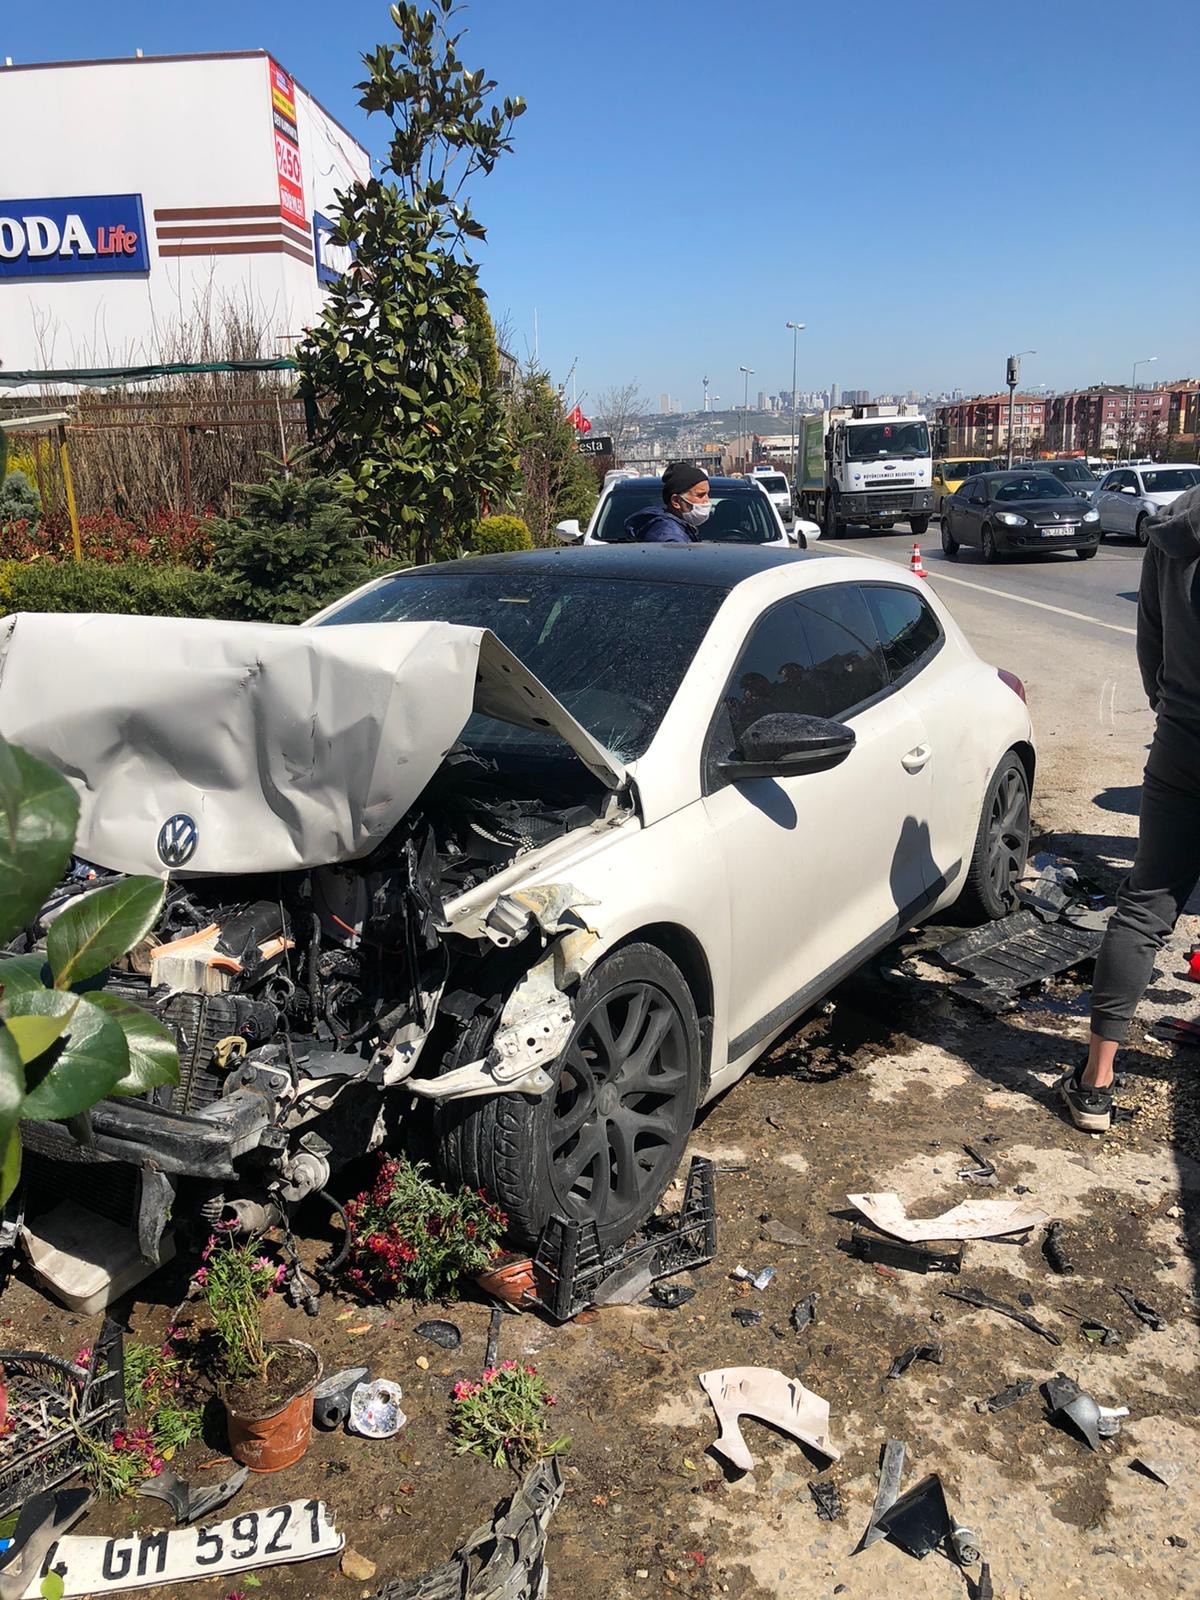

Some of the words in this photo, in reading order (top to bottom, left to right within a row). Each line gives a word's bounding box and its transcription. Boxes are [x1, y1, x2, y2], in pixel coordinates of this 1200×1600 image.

[276, 140, 300, 182] %50
[0, 214, 97, 258] ODA
[97, 224, 138, 254] Life
[102, 1531, 169, 1581] GM
[196, 1500, 320, 1566] 5921
